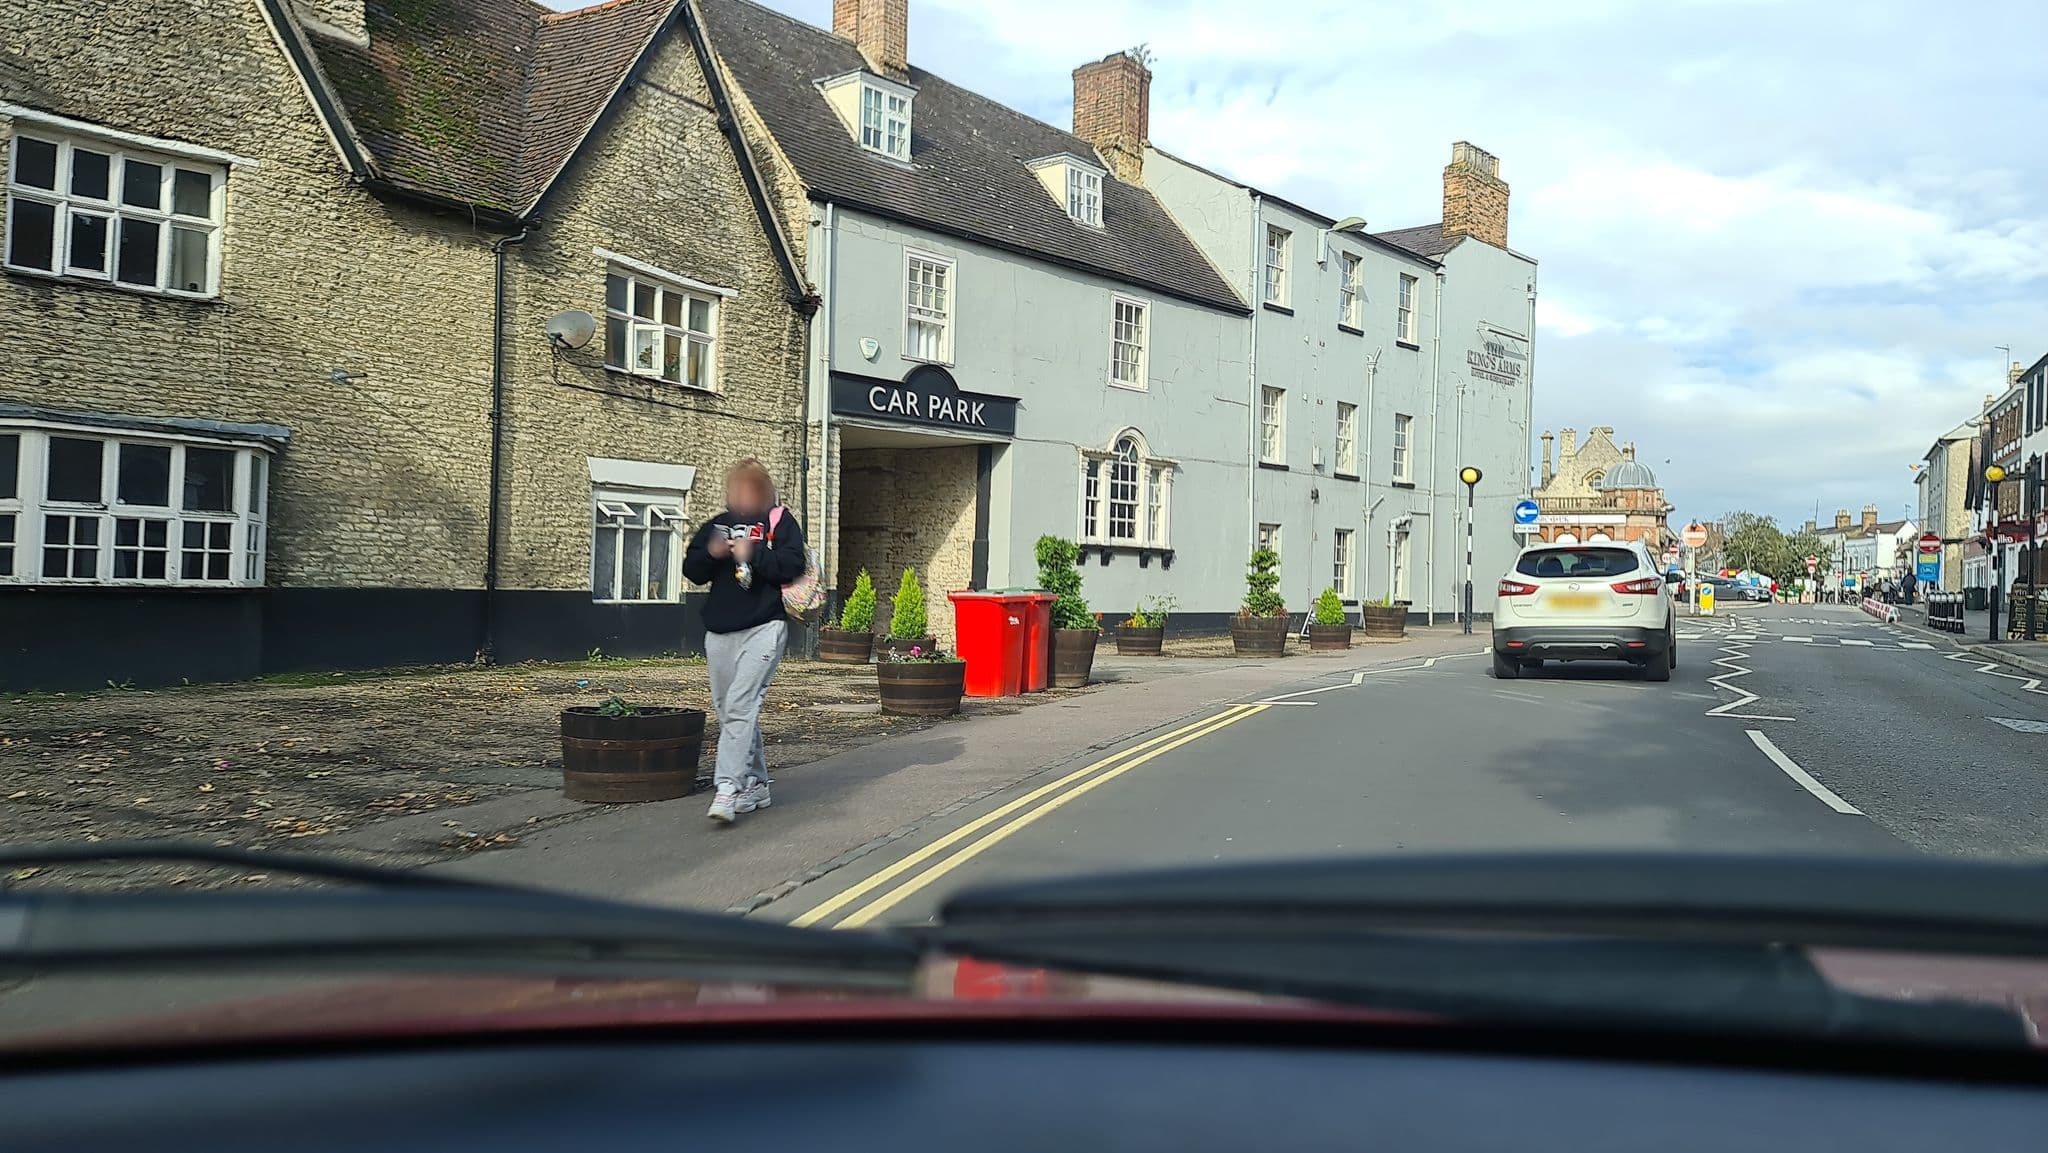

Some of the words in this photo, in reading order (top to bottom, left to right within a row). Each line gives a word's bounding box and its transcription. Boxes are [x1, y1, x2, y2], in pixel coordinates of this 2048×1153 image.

[1467, 349, 1496, 370] KING'S
[1498, 359, 1521, 377] ARMS
[869, 386, 920, 417] CAR
[928, 395, 986, 426] PARK
